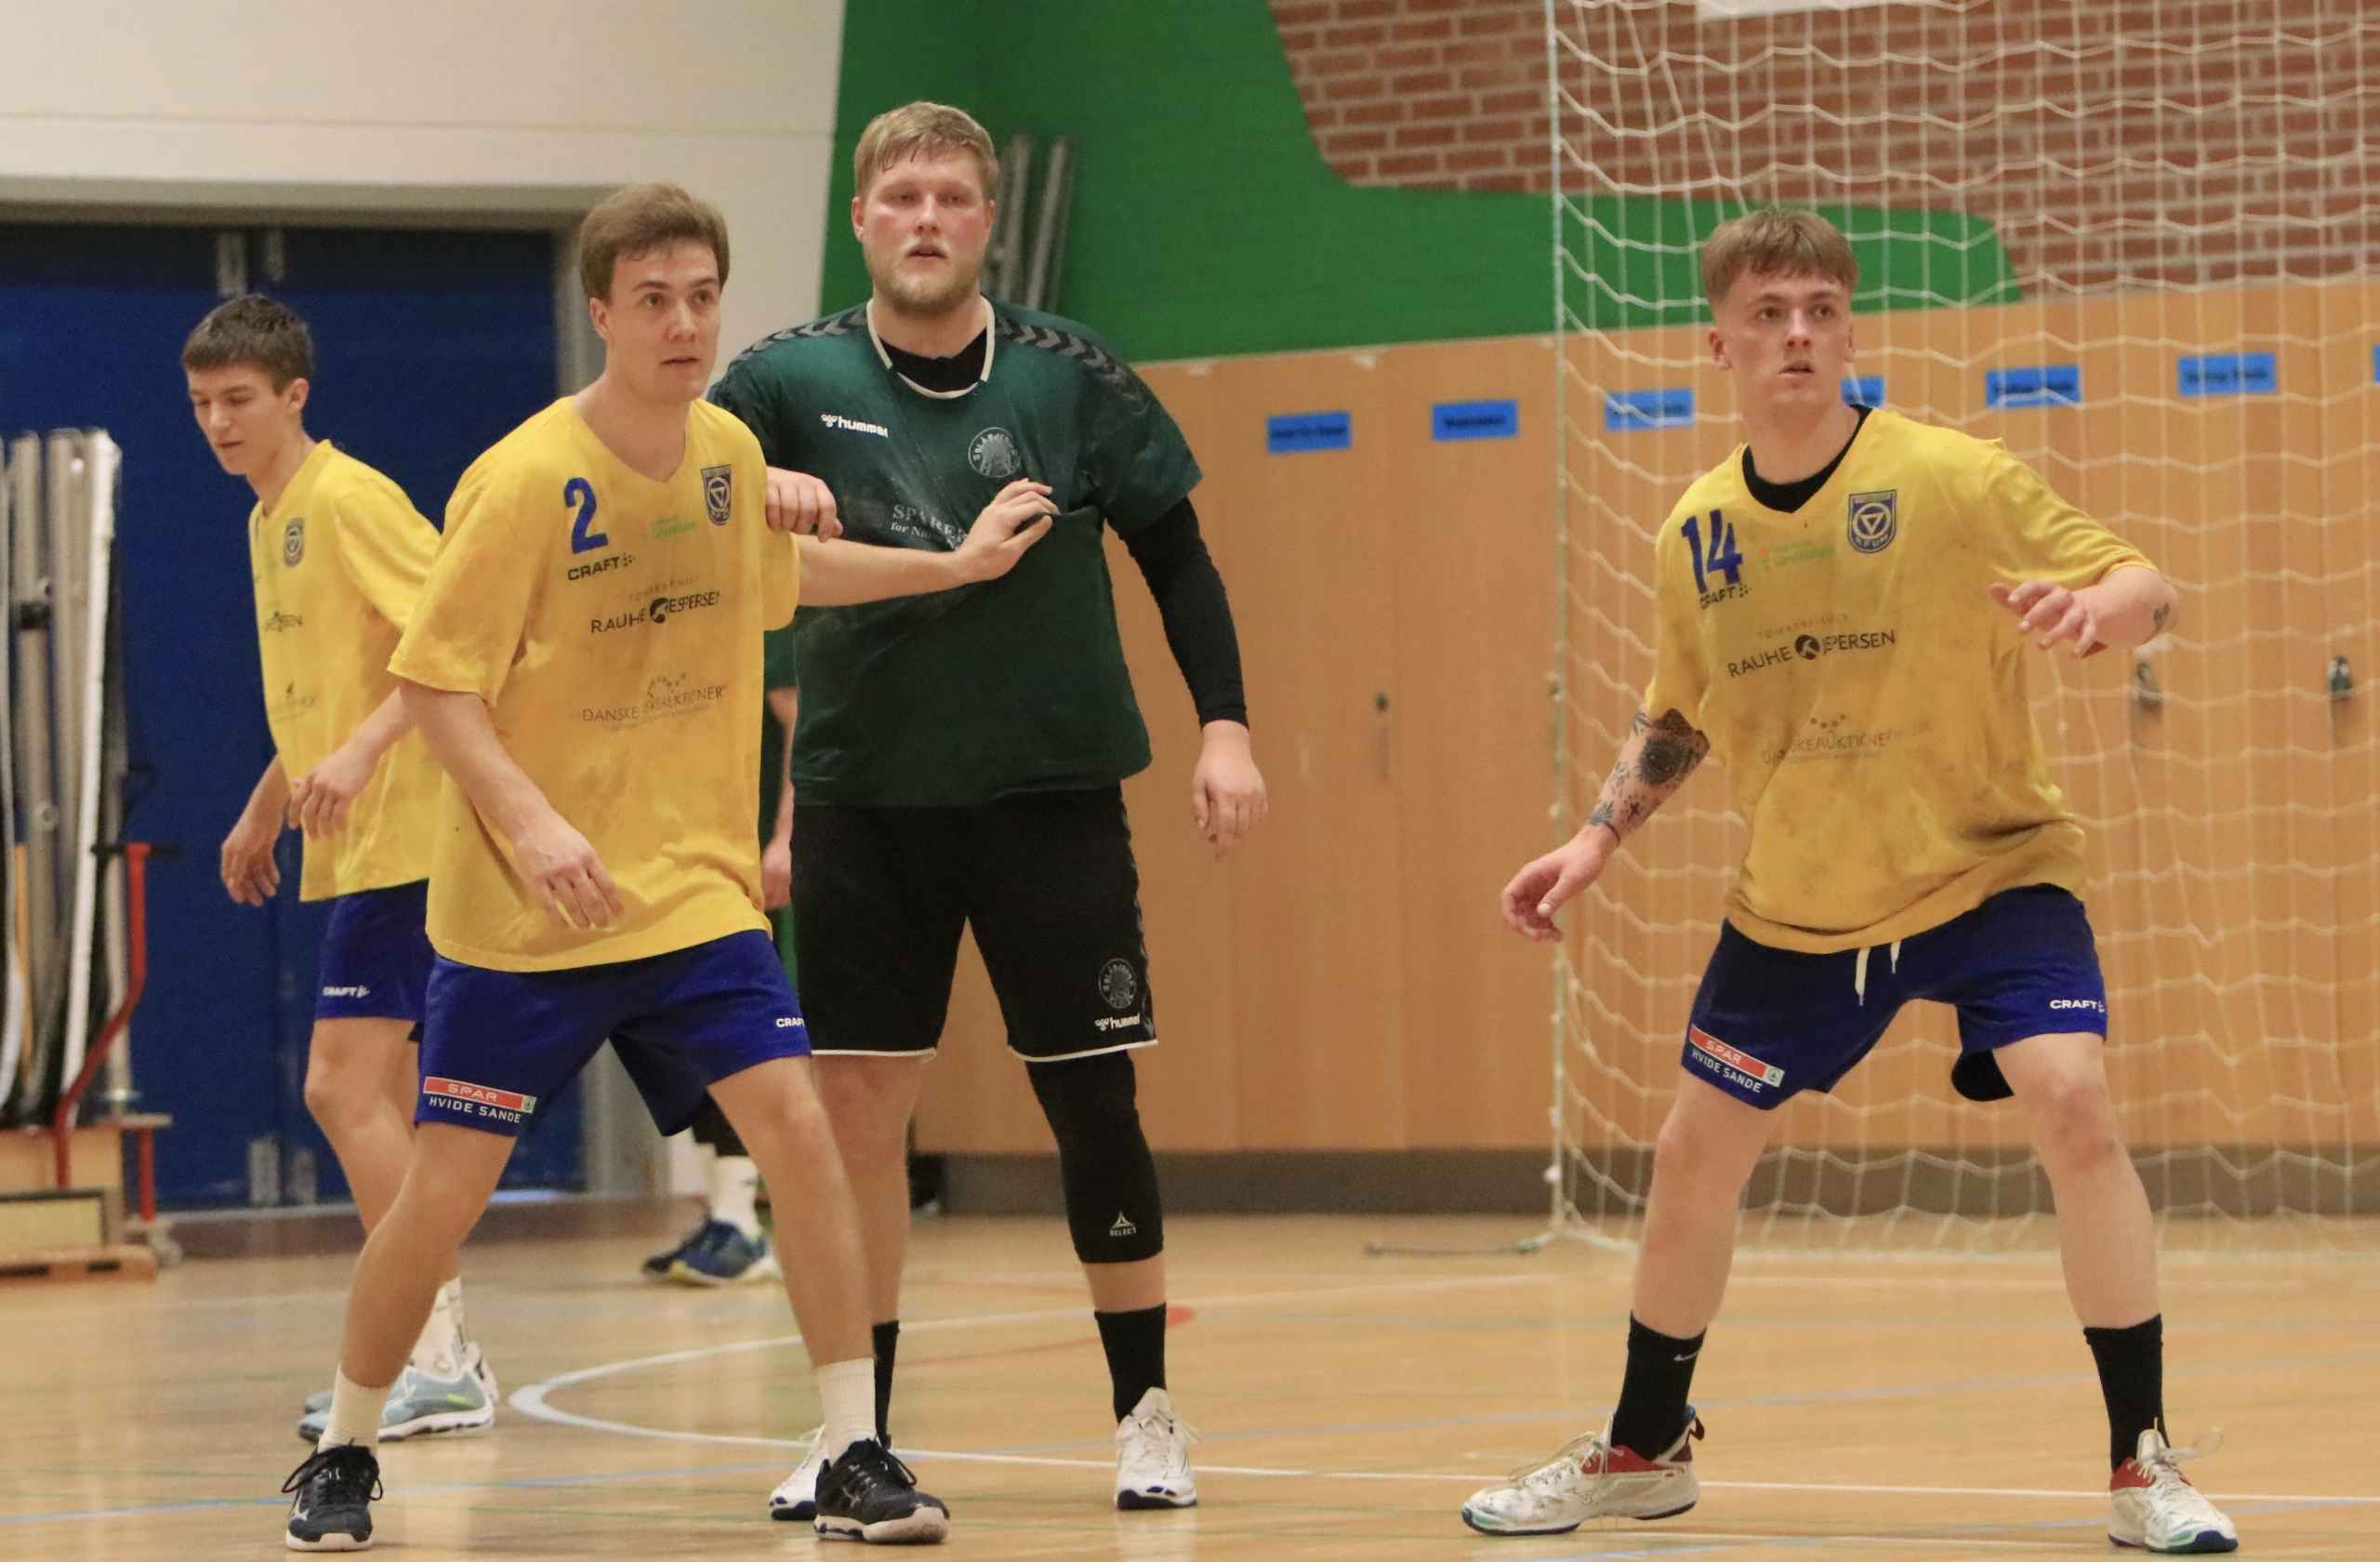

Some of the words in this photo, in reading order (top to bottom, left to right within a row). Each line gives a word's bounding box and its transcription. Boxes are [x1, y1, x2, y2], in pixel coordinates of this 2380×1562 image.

[838, 415, 889, 438] hummel
[563, 476, 609, 555] 2
[1680, 508, 1744, 595] 14
[566, 556, 621, 581] CRAFT
[590, 607, 647, 634] RAUHE
[1727, 646, 1793, 679] RAUHE
[2049, 999, 2099, 1011] CRAFT
[1704, 1039, 1744, 1066] SPAR
[1692, 1047, 1723, 1074] HVIDE
[1722, 1066, 1764, 1093] SANDE
[447, 1083, 499, 1104] SPAR
[428, 1095, 473, 1114] HVIDE
[478, 1105, 522, 1124] SANDE
